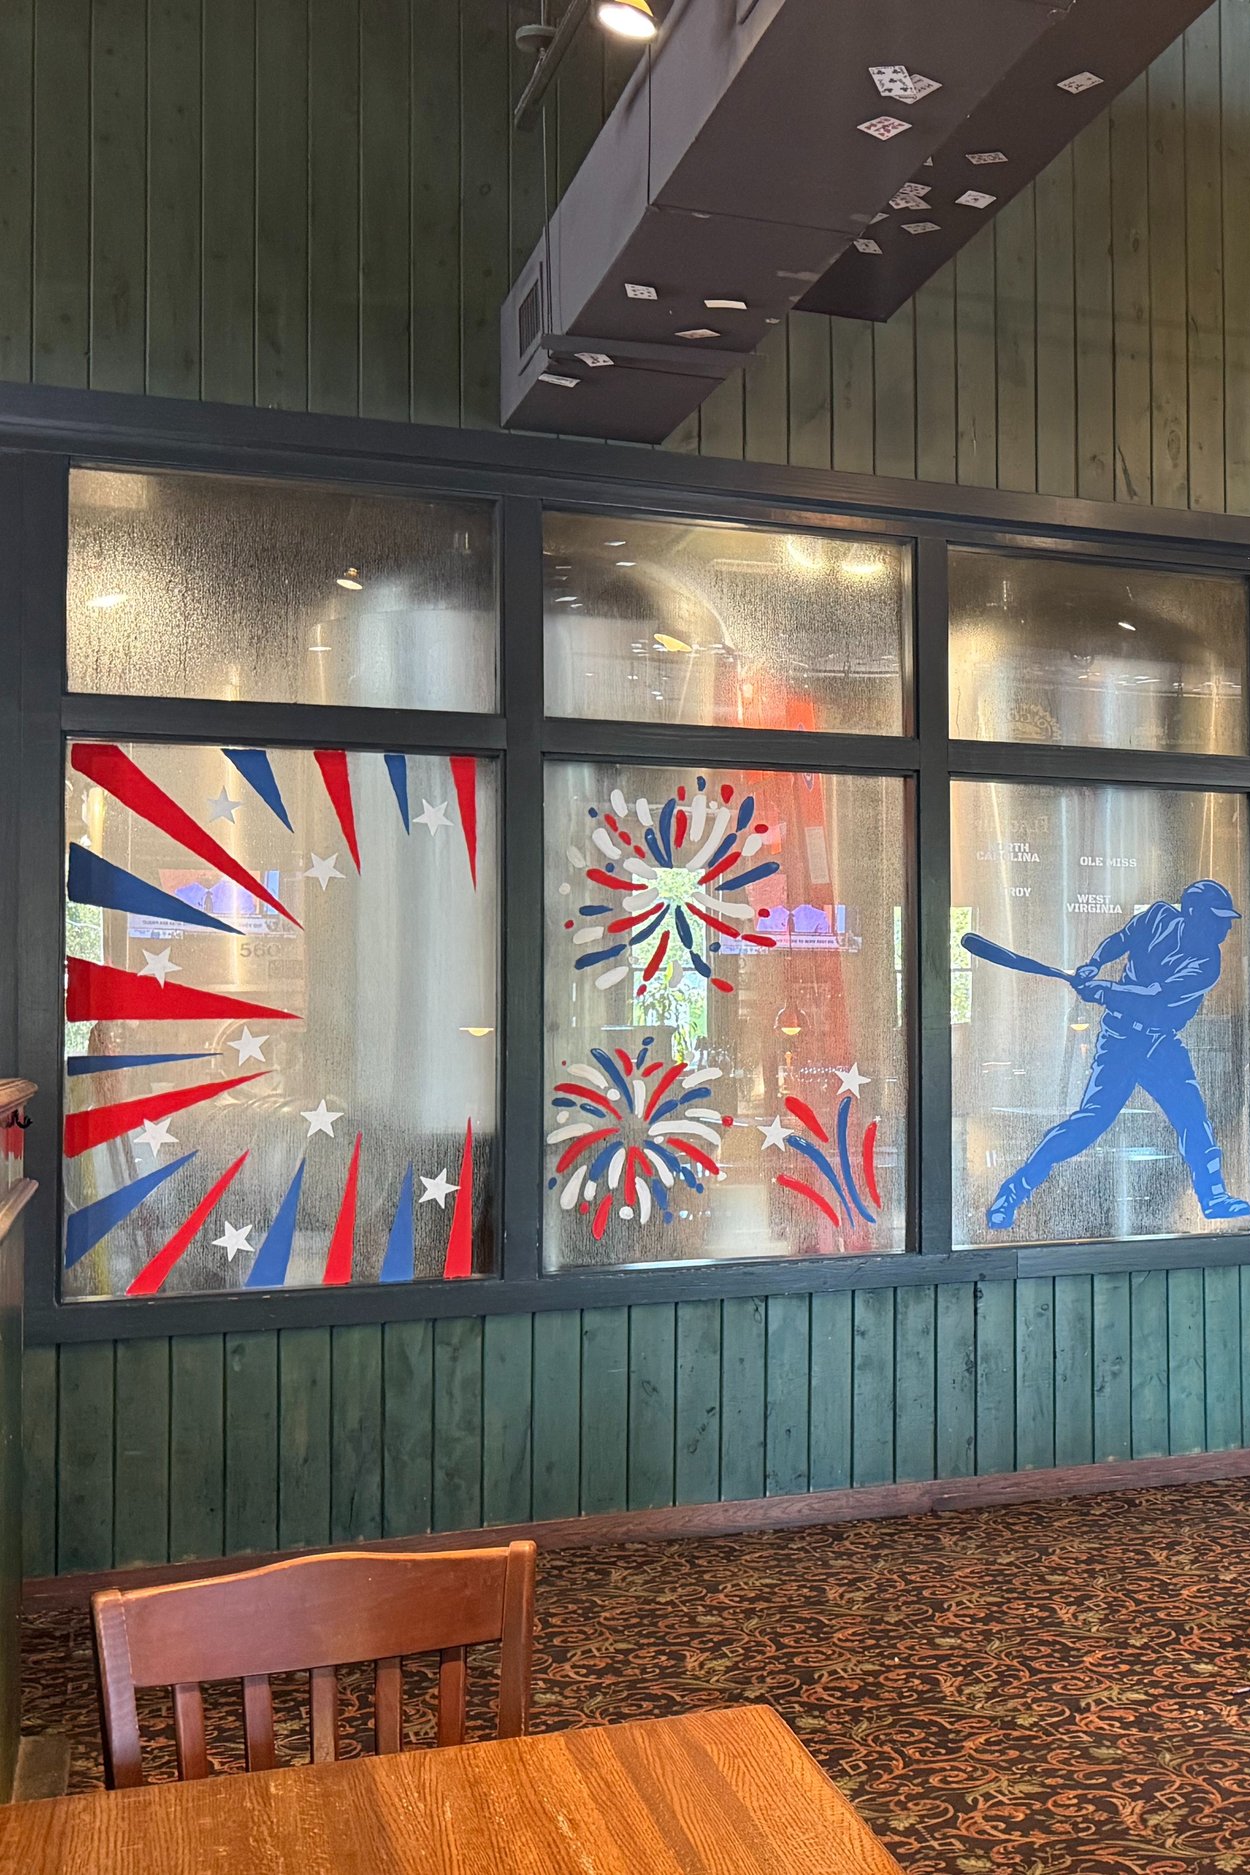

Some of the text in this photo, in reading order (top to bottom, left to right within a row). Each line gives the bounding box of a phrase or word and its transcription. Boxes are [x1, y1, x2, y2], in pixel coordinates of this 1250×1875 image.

[988, 842, 1030, 853] NRTH
[1079, 856, 1137, 868] OLE MISS
[1003, 887, 1032, 897] ROY
[1077, 894, 1111, 904] WEST
[1066, 903, 1123, 914] VIRGINIA
